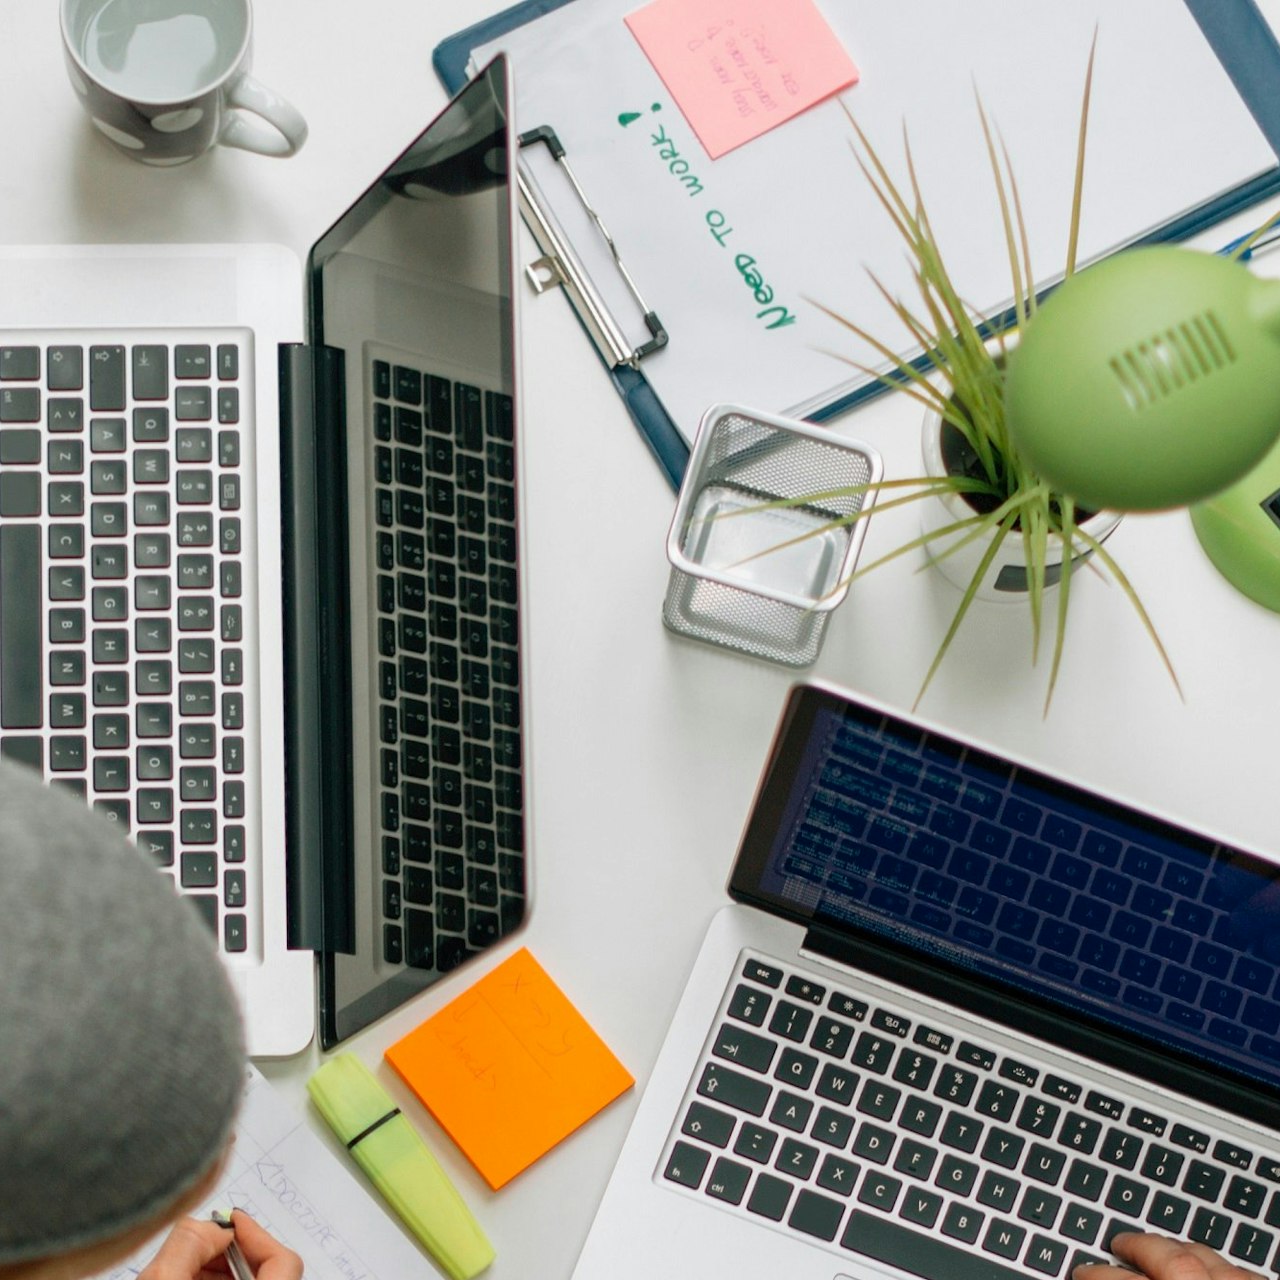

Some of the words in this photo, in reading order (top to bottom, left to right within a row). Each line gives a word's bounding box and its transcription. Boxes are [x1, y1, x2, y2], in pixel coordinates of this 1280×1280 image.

[705, 209, 734, 248] TO
[144, 418, 157, 430] Q
[102, 430, 114, 440] A
[181, 440, 193, 448] 2
[59, 452, 72, 461] Z
[145, 459, 157, 472] W
[102, 473, 115, 482] S
[181, 482, 193, 491] 3
[60, 493, 72, 504] X
[102, 514, 115, 524] D
[60, 535, 73, 545] C
[145, 545, 158, 555] R
[103, 557, 116, 565] F
[182, 567, 194, 575] 5
[61, 578, 73, 588] V
[147, 588, 159, 596] T
[103, 598, 116, 609] G
[183, 608, 195, 618] 6
[60, 620, 74, 630] B
[147, 630, 159, 639] Y
[104, 640, 116, 651] H
[183, 651, 196, 660] 7
[62, 662, 74, 673] N
[147, 672, 160, 683] U
[104, 684, 117, 692] J
[184, 693, 197, 702] 8
[61, 703, 74, 717] M
[105, 726, 117, 736] K
[185, 736, 197, 745] 9
[148, 756, 161, 769] O
[105, 770, 118, 778] L
[185, 779, 197, 788] 0
[149, 801, 161, 810] P
[756, 968, 771, 979] esc
[790, 1009, 798, 1021] !
[829, 1024, 841, 1036] @
[871, 1041, 881, 1052] #
[912, 1056, 922, 1069] $
[953, 1071, 964, 1085] %
[1036, 1104, 1046, 1117] &
[786, 1021, 793, 1034] 1
[824, 1037, 835, 1050] 2
[866, 1052, 876, 1066] 3
[907, 1069, 918, 1081] 4
[949, 1084, 959, 1097] 5
[990, 1101, 1000, 1113] 6
[1032, 1116, 1043, 1128] 7
[1073, 1133, 1083, 1145] 8
[1115, 1148, 1124, 1161] 9
[1155, 1164, 1166, 1177] 0
[791, 1061, 803, 1076] Q
[831, 1076, 846, 1092] W
[874, 1093, 885, 1107] E
[915, 1109, 926, 1123] R
[958, 1125, 968, 1138] T
[1000, 1140, 1010, 1153] Y
[1039, 1156, 1052, 1170] U
[1121, 1189, 1134, 1202] O
[1163, 1204, 1174, 1217] P
[785, 1105, 796, 1119] A
[828, 1120, 838, 1134] S
[868, 1136, 880, 1149] D
[911, 1152, 922, 1165] F
[951, 1168, 964, 1182] G
[992, 1184, 1005, 1198] H
[1035, 1201, 1045, 1213] J
[1075, 1216, 1088, 1230] K
[671, 1166, 681, 1178] fn
[711, 1183, 725, 1194] ctrl
[791, 1151, 804, 1166] Z
[832, 1167, 845, 1182] X
[874, 1184, 886, 1198] C
[918, 1199, 928, 1213] V
[957, 1215, 968, 1229] B
[998, 1231, 1012, 1246] N
[1038, 1247, 1053, 1263] M
